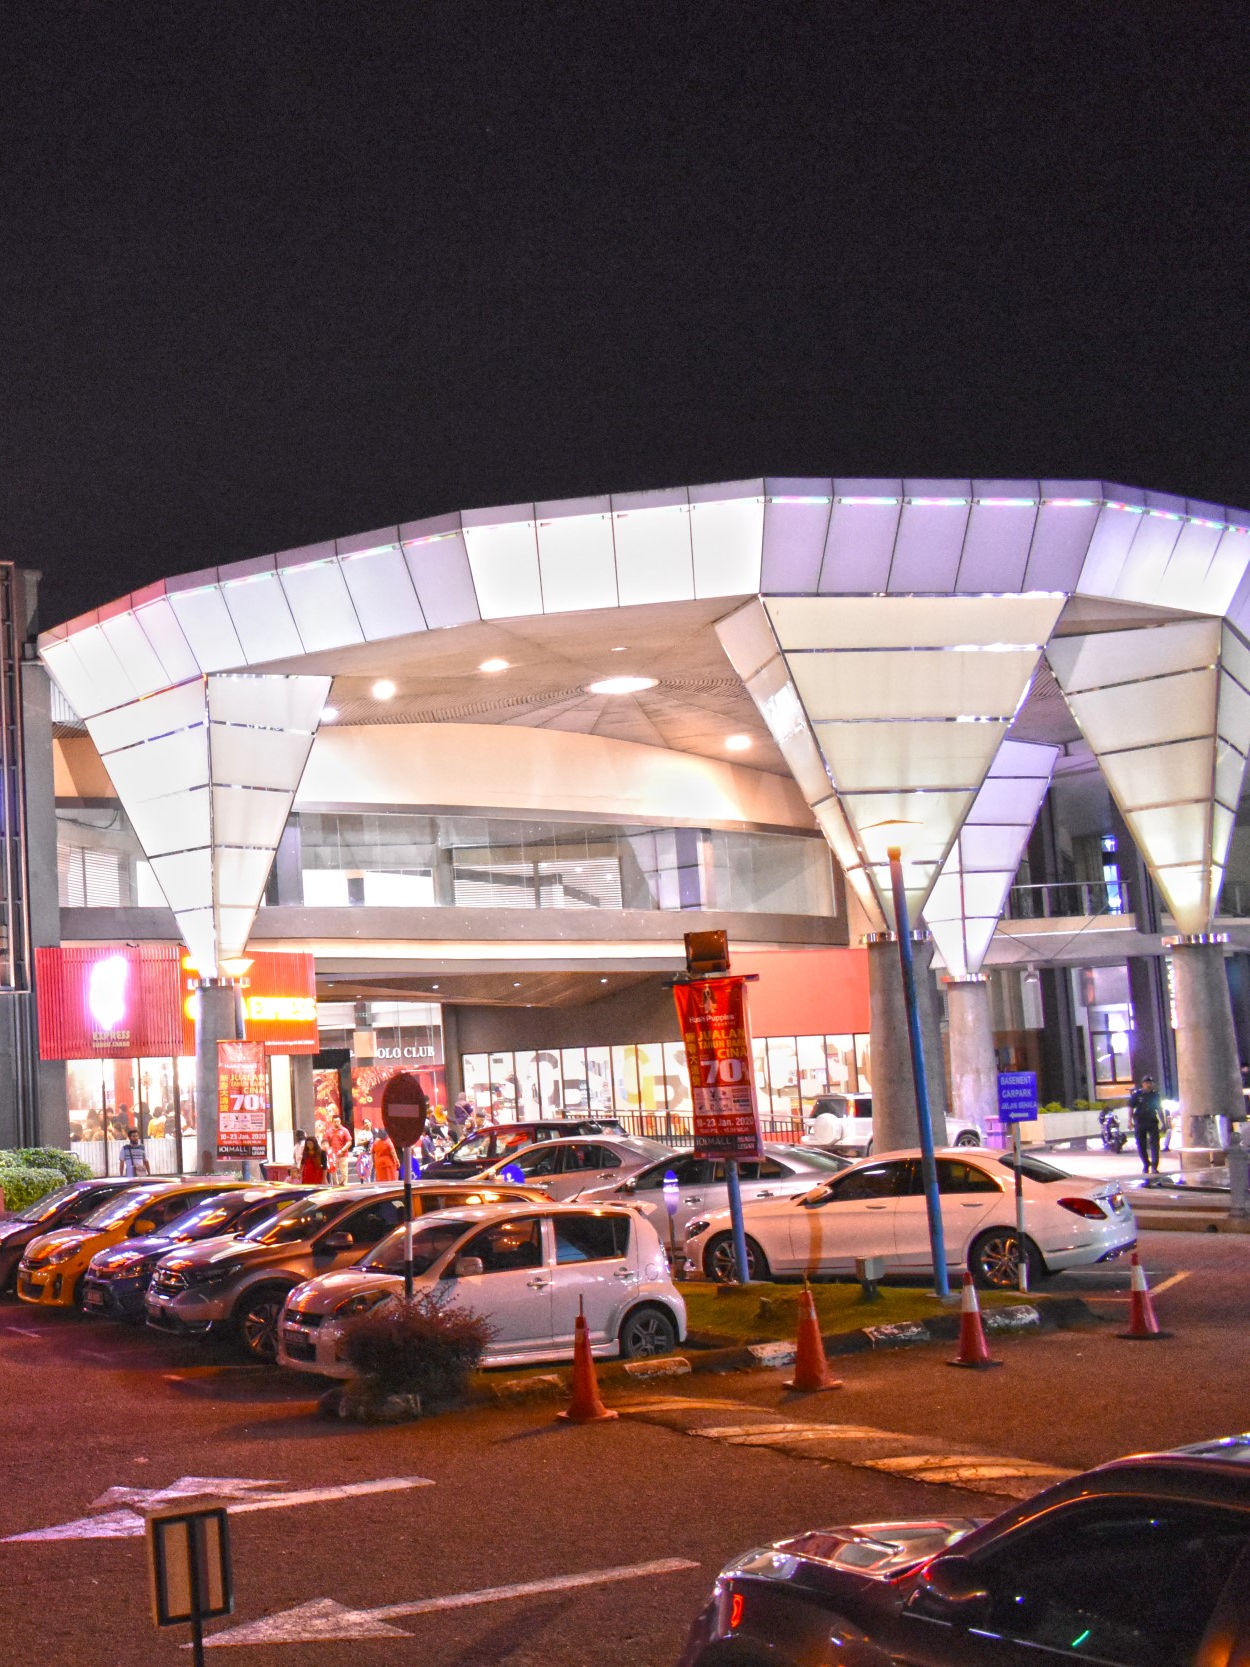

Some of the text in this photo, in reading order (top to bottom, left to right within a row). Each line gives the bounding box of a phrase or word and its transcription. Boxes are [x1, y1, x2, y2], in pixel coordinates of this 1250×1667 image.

[698, 1029, 745, 1041] JUALAN
[698, 1040, 725, 1050] TAHUN
[403, 1046, 435, 1058] CLUB
[717, 1048, 748, 1058] CINA
[1000, 1076, 1031, 1085] BASEMENT
[1002, 1089, 1032, 1098] CARPARK
[718, 1118, 734, 1127] Jan.
[736, 1117, 754, 1126] 2020
